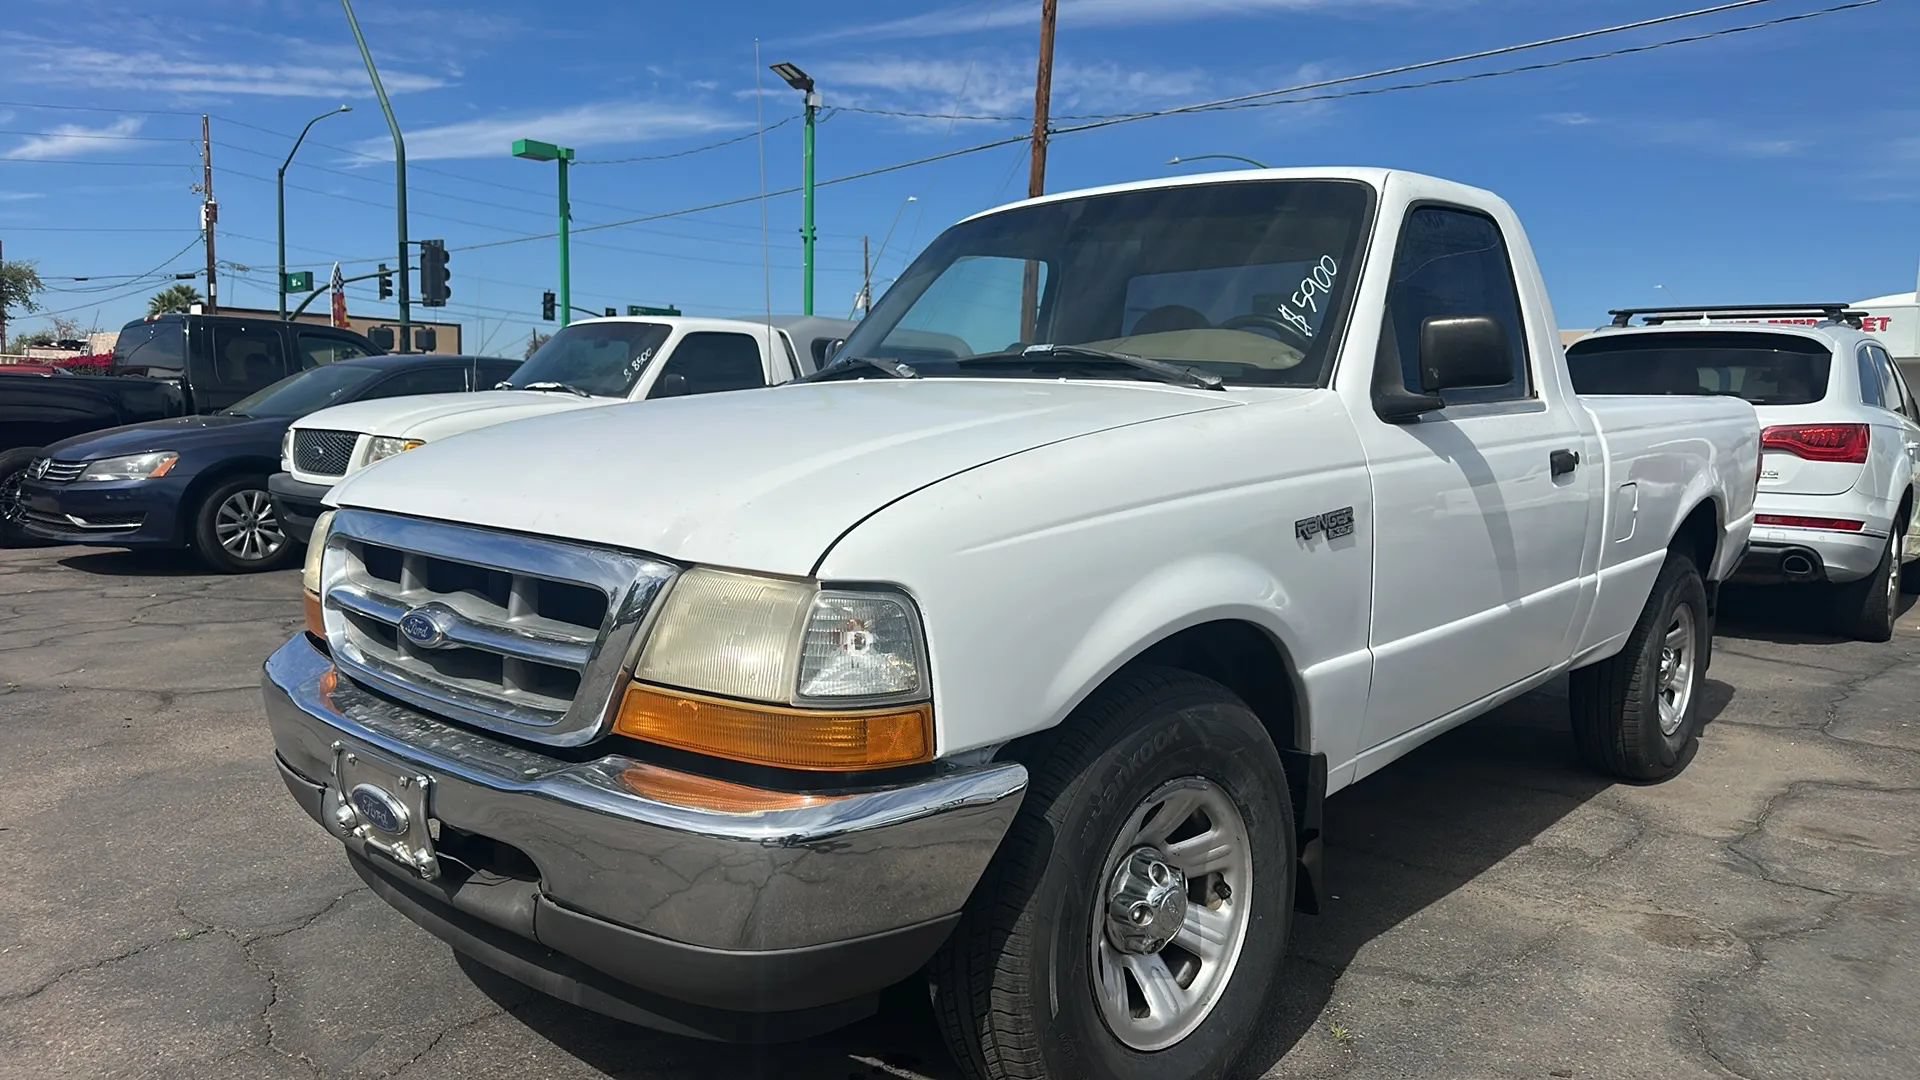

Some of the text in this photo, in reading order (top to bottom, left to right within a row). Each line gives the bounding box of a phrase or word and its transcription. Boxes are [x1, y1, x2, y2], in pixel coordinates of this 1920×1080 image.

[1277, 254, 1338, 338] $5900
[404, 617, 430, 638] Ford
[362, 795, 390, 826] Ford
